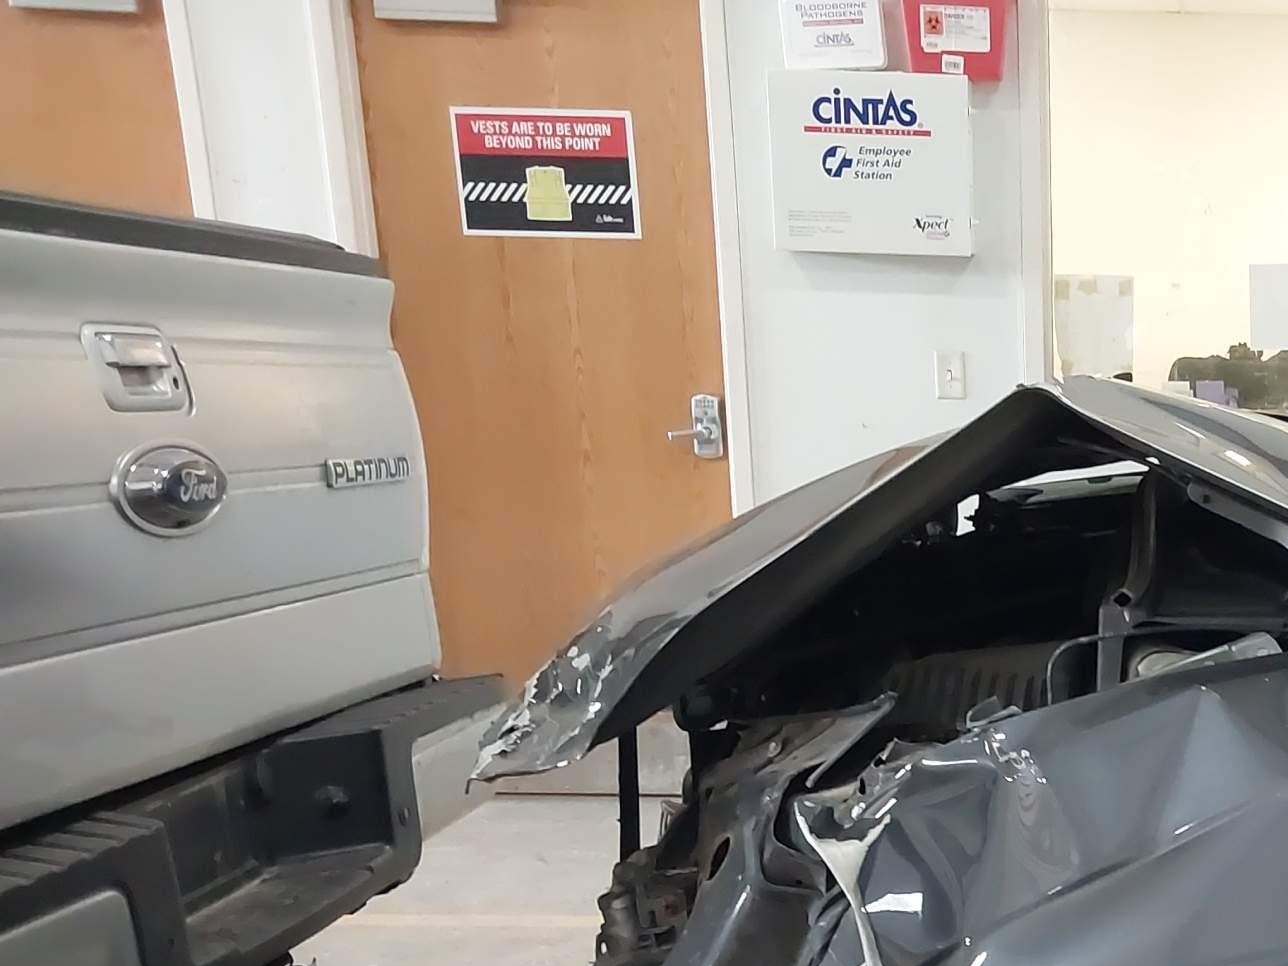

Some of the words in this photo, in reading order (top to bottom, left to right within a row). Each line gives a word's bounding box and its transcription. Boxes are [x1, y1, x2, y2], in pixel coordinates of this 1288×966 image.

[795, 2, 867, 12] BLOODBORNE
[801, 10, 864, 19] PATHOGENS
[812, 87, 918, 127] CINTAS
[471, 120, 508, 135] VESTS
[511, 121, 536, 136] ARE
[537, 122, 553, 136] TO
[556, 122, 571, 136] BE
[574, 122, 611, 137] WORN
[484, 135, 533, 149] BEYOND
[535, 136, 563, 150] THIS
[565, 137, 601, 151] POINT
[858, 146, 912, 157] Employee
[856, 159, 880, 168] First
[882, 159, 902, 168] Aid
[853, 170, 893, 180] Station
[913, 217, 950, 233] Xpect
[332, 456, 410, 484] PLATINUM
[179, 467, 217, 503] Ford
